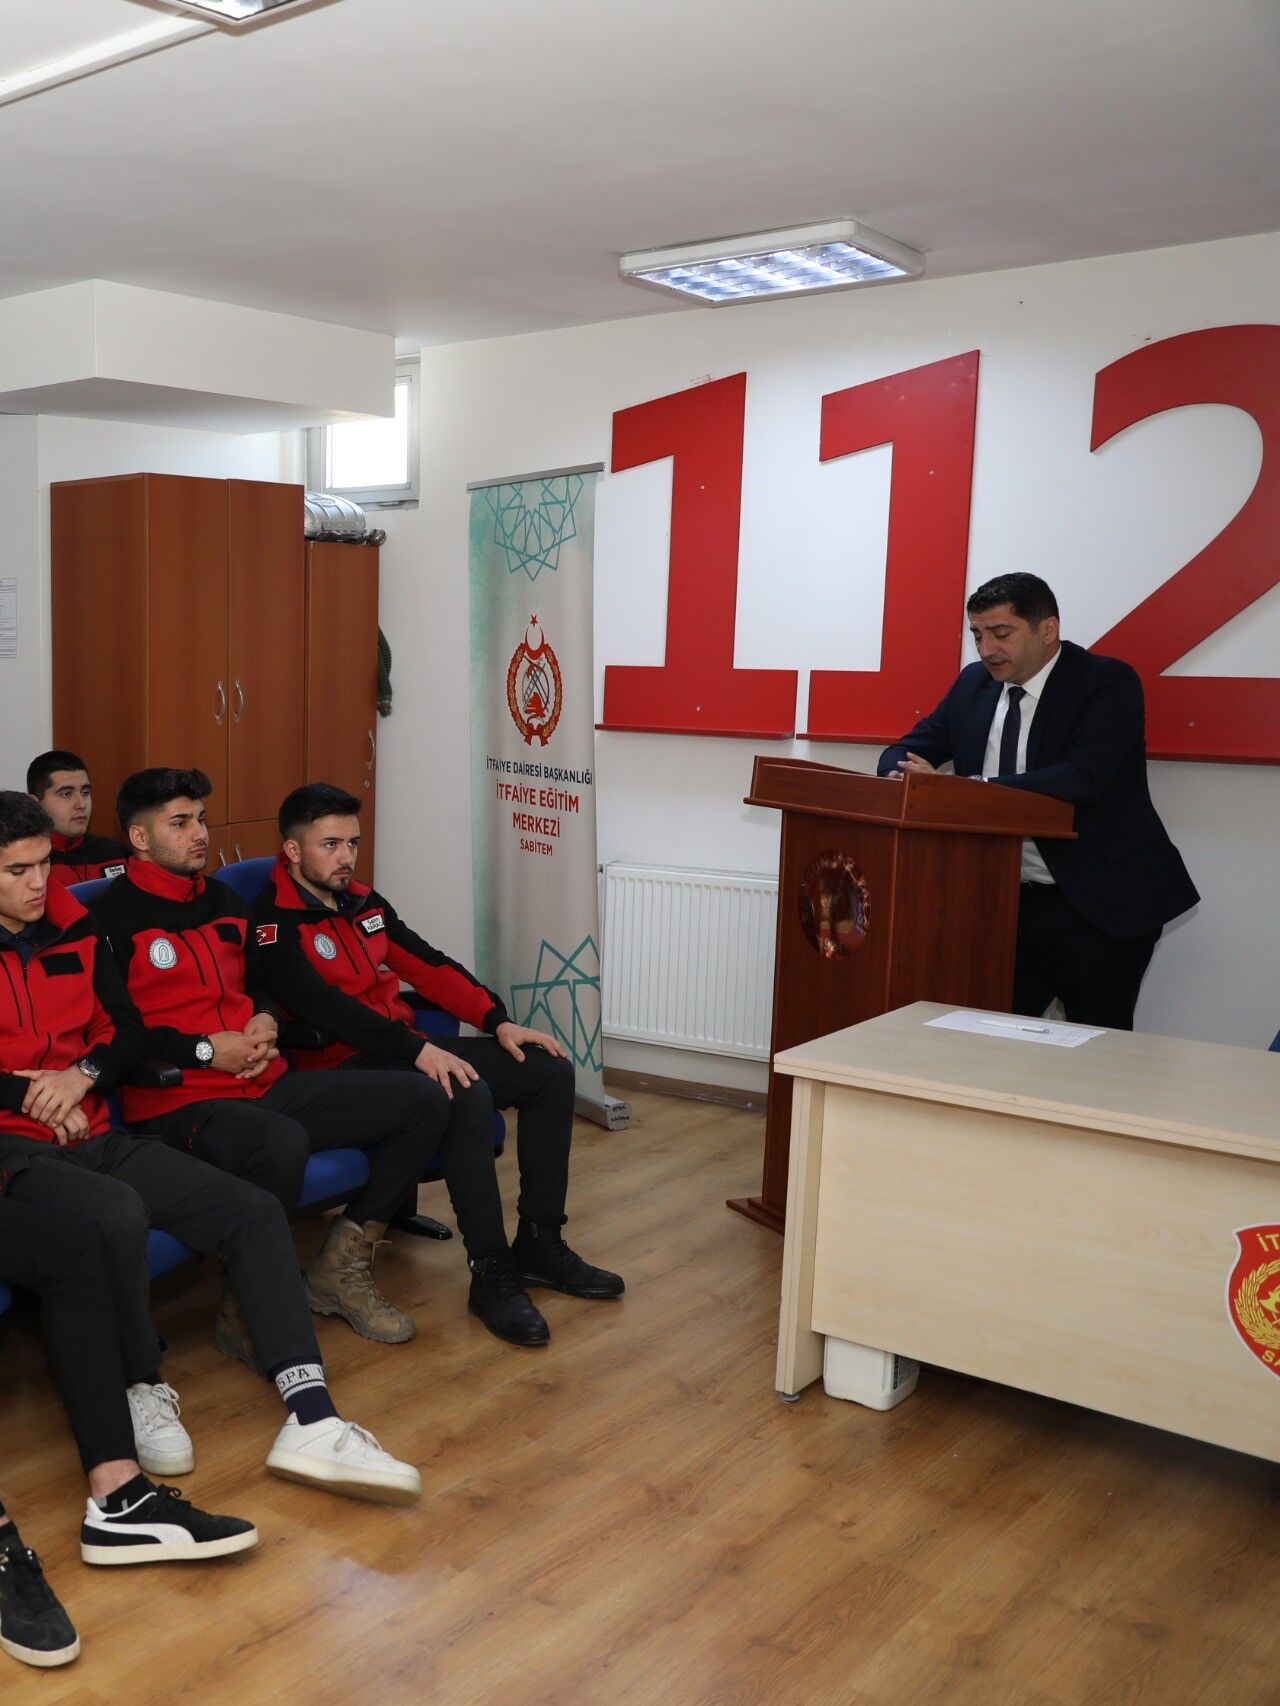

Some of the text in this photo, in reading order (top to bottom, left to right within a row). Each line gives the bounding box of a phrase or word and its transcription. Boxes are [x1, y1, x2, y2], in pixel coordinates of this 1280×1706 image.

[603, 323, 1280, 762] 112
[486, 755, 593, 785] İTFAİYE DAİRESİ BAŞKANLIĞI
[496, 780, 579, 813] İTFAİYE EĞİTİM
[512, 811, 560, 838] MERKEZİ
[520, 839, 553, 856] SABİTEM
[278, 1368, 310, 1389] SPA
